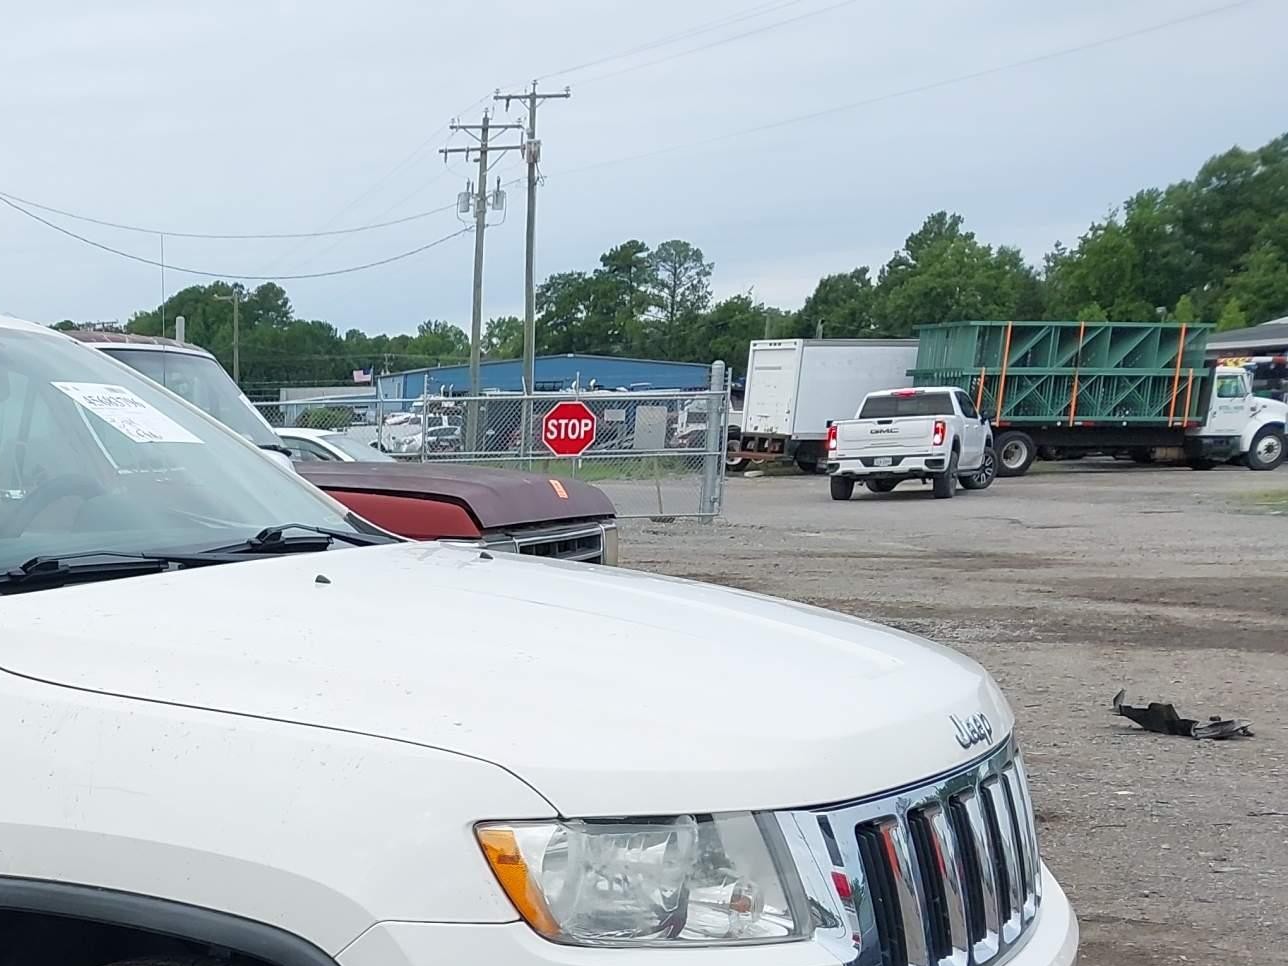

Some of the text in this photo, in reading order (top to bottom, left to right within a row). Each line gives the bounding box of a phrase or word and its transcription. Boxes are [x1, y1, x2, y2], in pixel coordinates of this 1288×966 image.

[546, 418, 592, 440] STOP
[869, 427, 900, 435] GMC
[948, 711, 994, 750] Jeep
